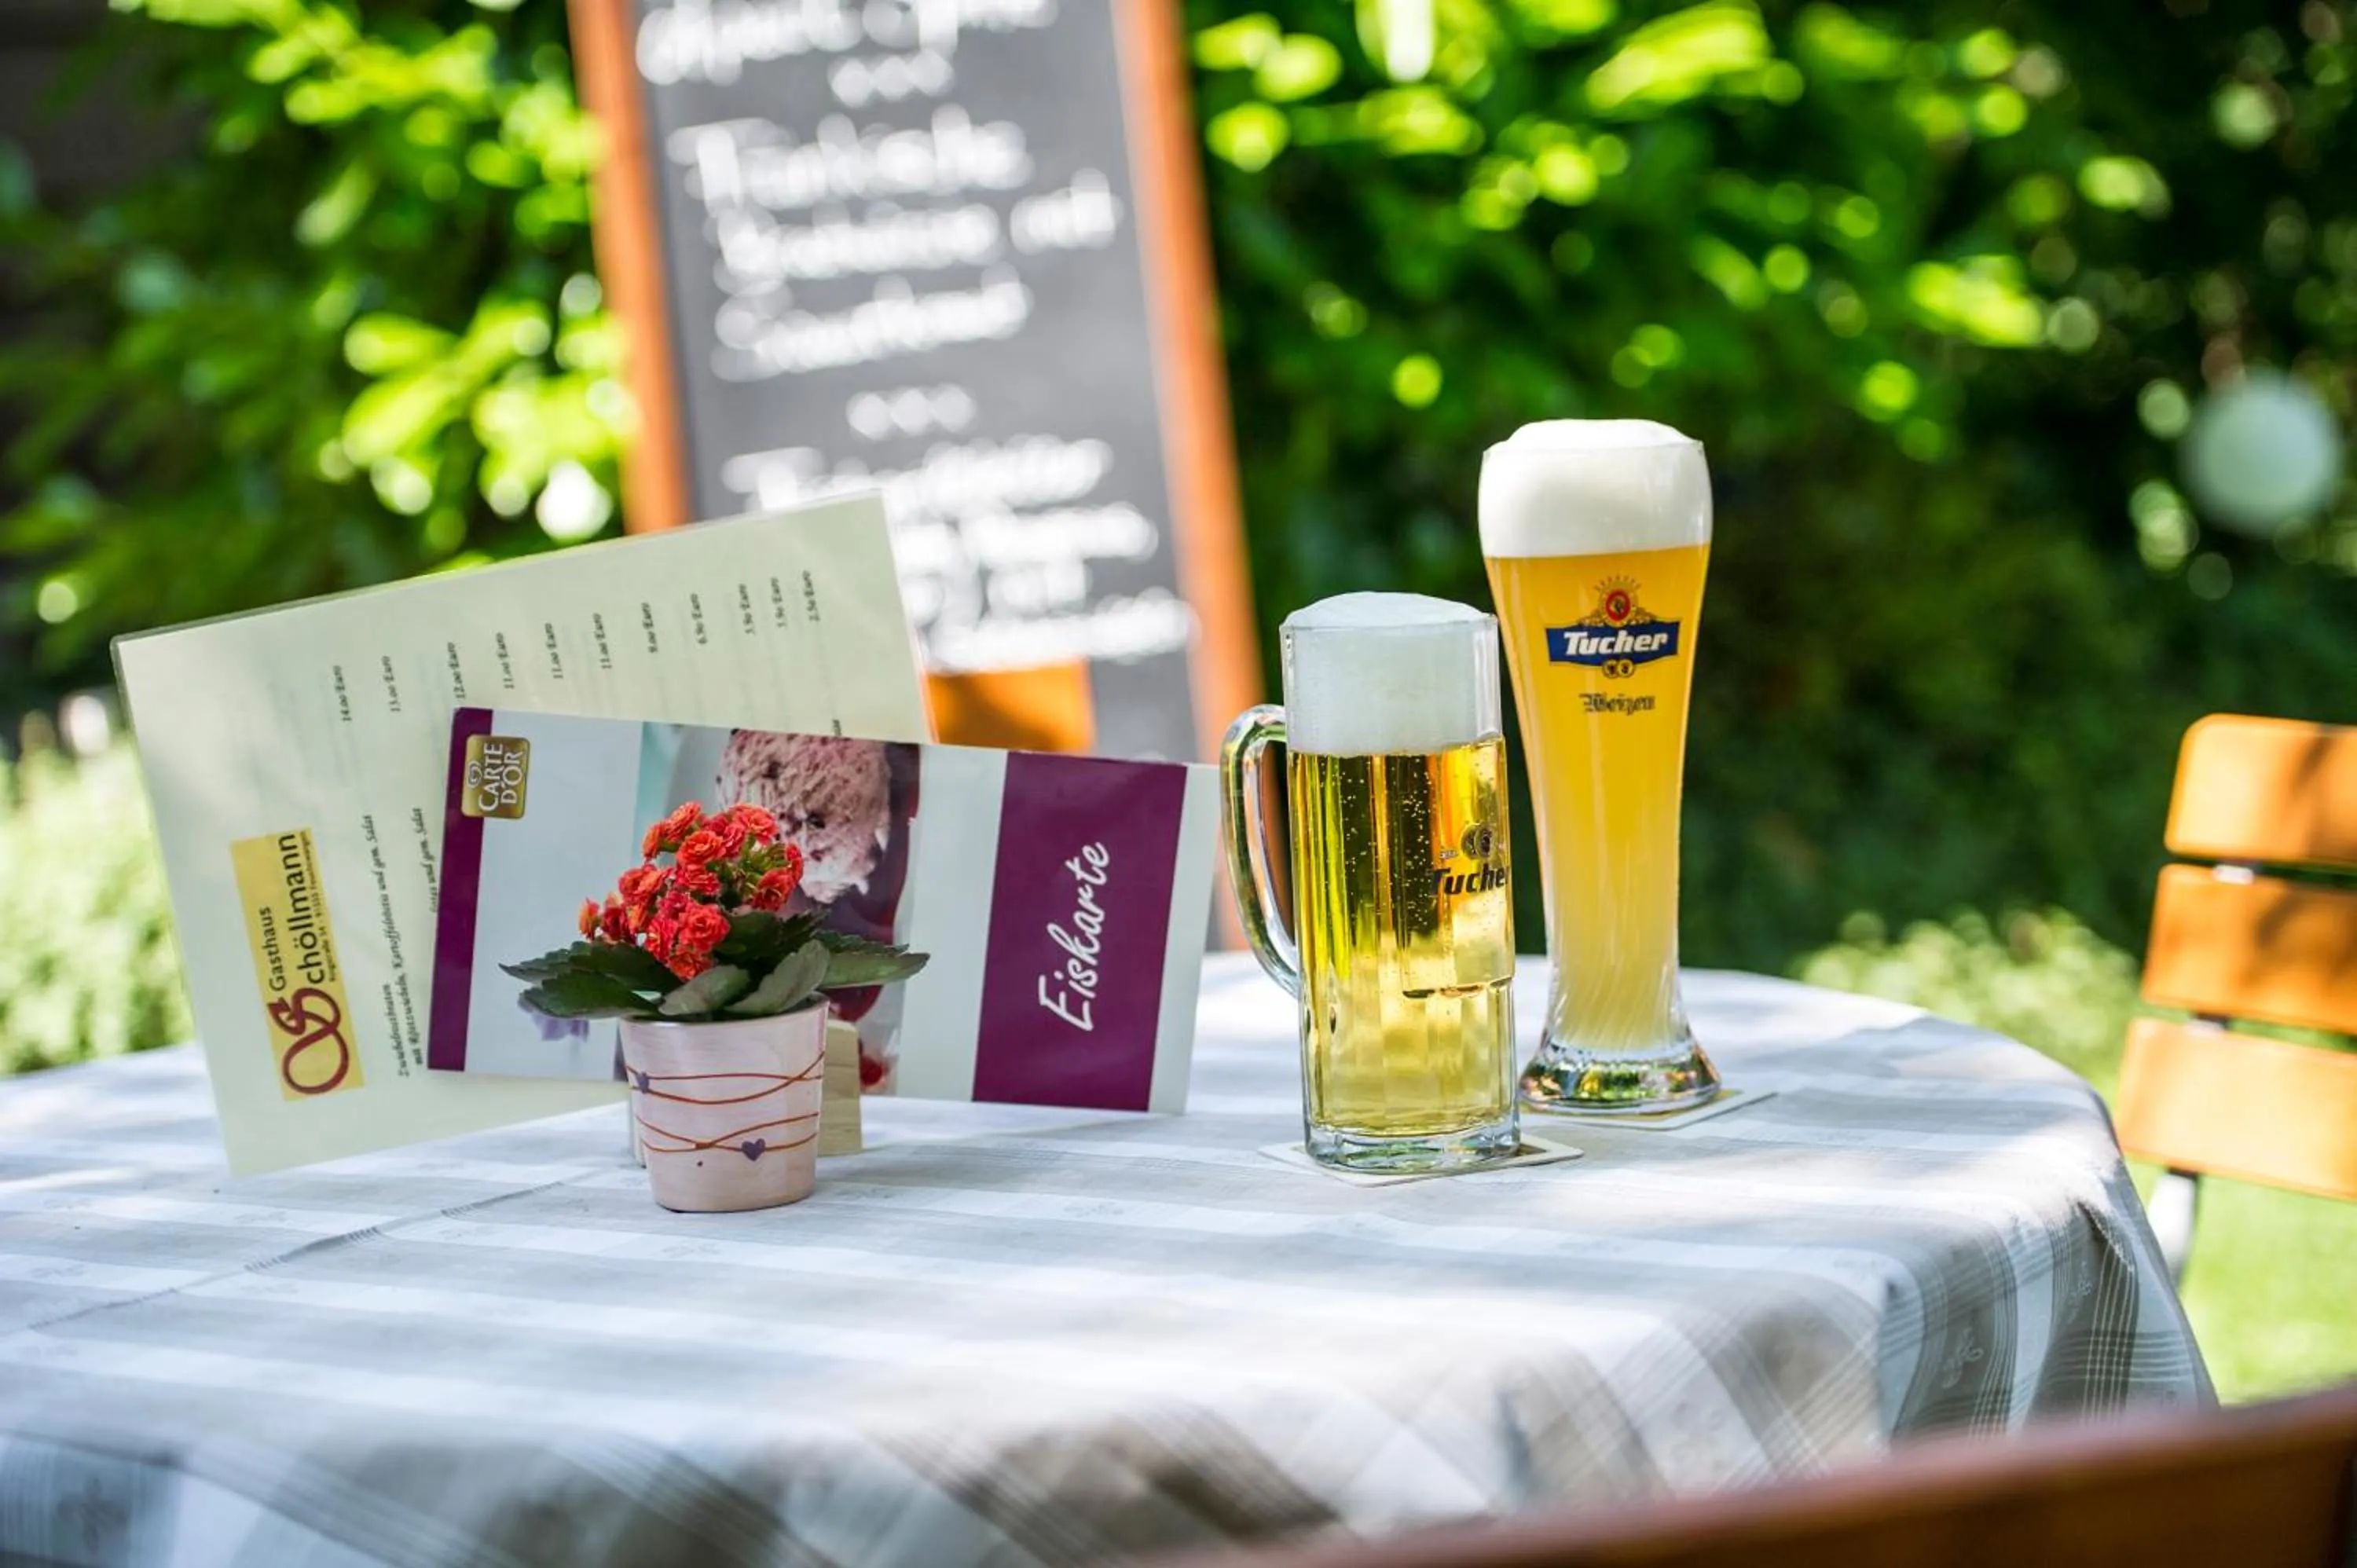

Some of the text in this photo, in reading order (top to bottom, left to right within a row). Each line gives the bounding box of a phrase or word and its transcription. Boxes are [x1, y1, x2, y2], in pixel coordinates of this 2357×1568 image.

[544, 623, 557, 650] Euro
[592, 613, 606, 640] Euro
[447, 642, 460, 669] Euro
[496, 632, 508, 660] Euro
[1563, 630, 1669, 656] Tucher
[333, 665, 345, 693] Euro
[382, 655, 394, 683] Euro
[478, 743, 504, 811] CARTE
[500, 751, 524, 804] D'OR
[361, 815, 378, 843] Salat
[410, 808, 427, 836] Salat
[371, 869, 386, 890] und
[1428, 863, 1509, 895] Tuche
[259, 906, 287, 991] Gasthaus
[1037, 841, 1111, 1032] Eiskarte
